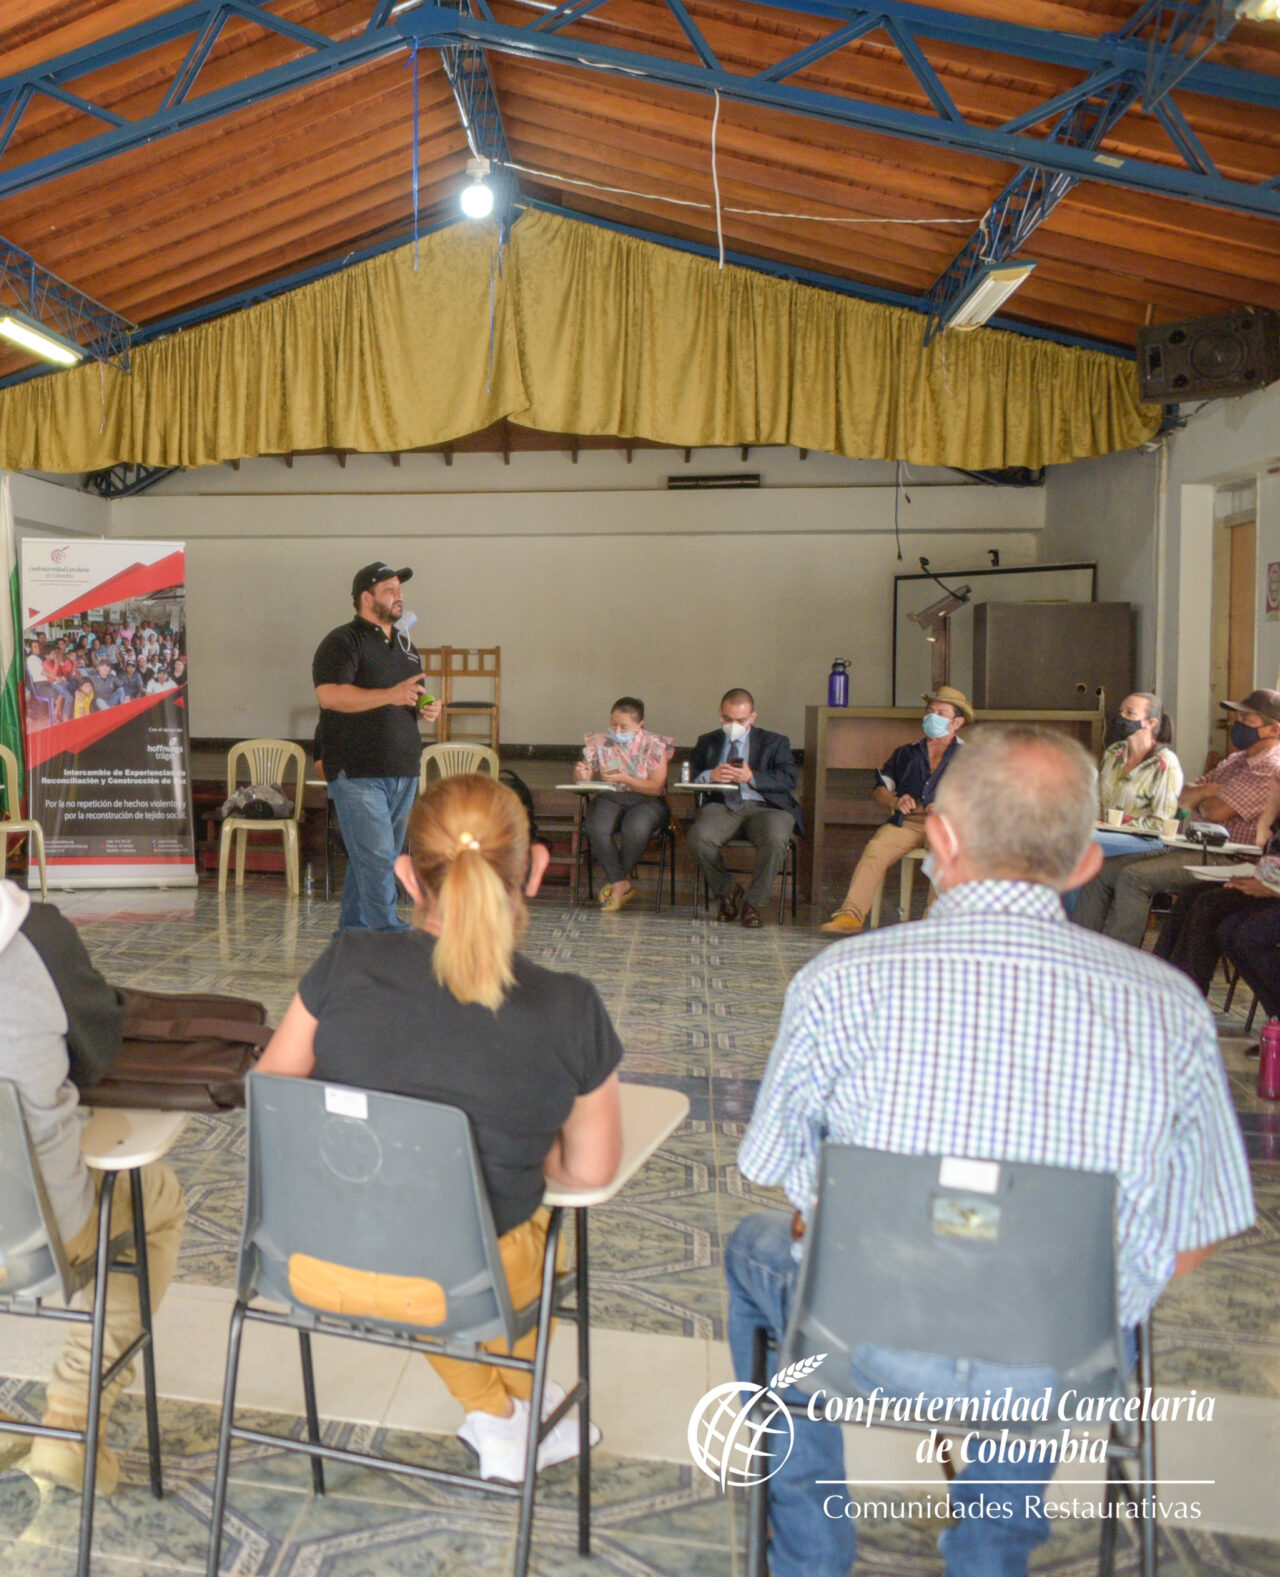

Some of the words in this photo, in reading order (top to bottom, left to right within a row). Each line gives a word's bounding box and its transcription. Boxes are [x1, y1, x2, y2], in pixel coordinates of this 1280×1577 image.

[63, 769, 111, 777] Intercambio
[113, 769, 123, 777] de
[41, 777, 99, 785] Reconciliación
[107, 777, 160, 785] Construcción
[45, 799, 57, 808] Por
[58, 799, 65, 808] la
[77, 799, 112, 810] repetición
[113, 799, 123, 808] de
[124, 799, 149, 808] hechos
[64, 812, 77, 821] por
[78, 811, 85, 820] la
[134, 811, 144, 820] de
[145, 811, 165, 821] tejido
